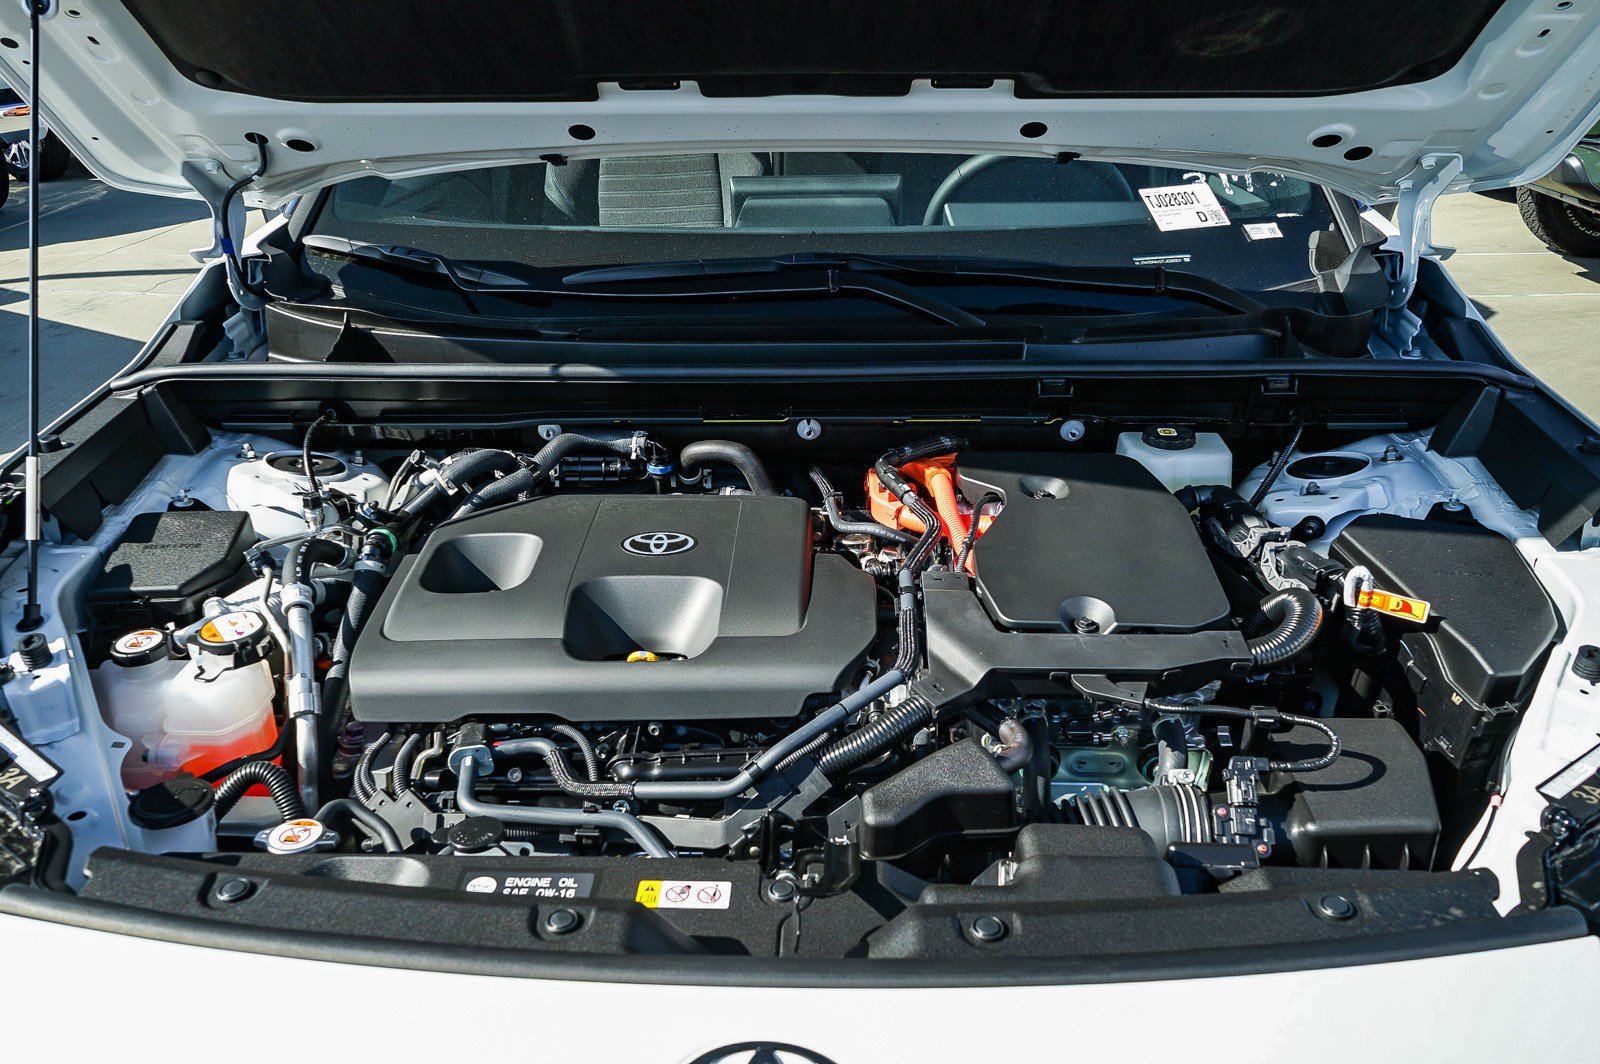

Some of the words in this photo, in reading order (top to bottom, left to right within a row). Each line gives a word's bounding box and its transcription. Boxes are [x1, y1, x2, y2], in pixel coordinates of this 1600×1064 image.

[1145, 190, 1200, 209] TJ028301
[1196, 211, 1208, 223] D
[504, 876, 552, 888] ENGINE
[557, 877, 579, 888] OIL
